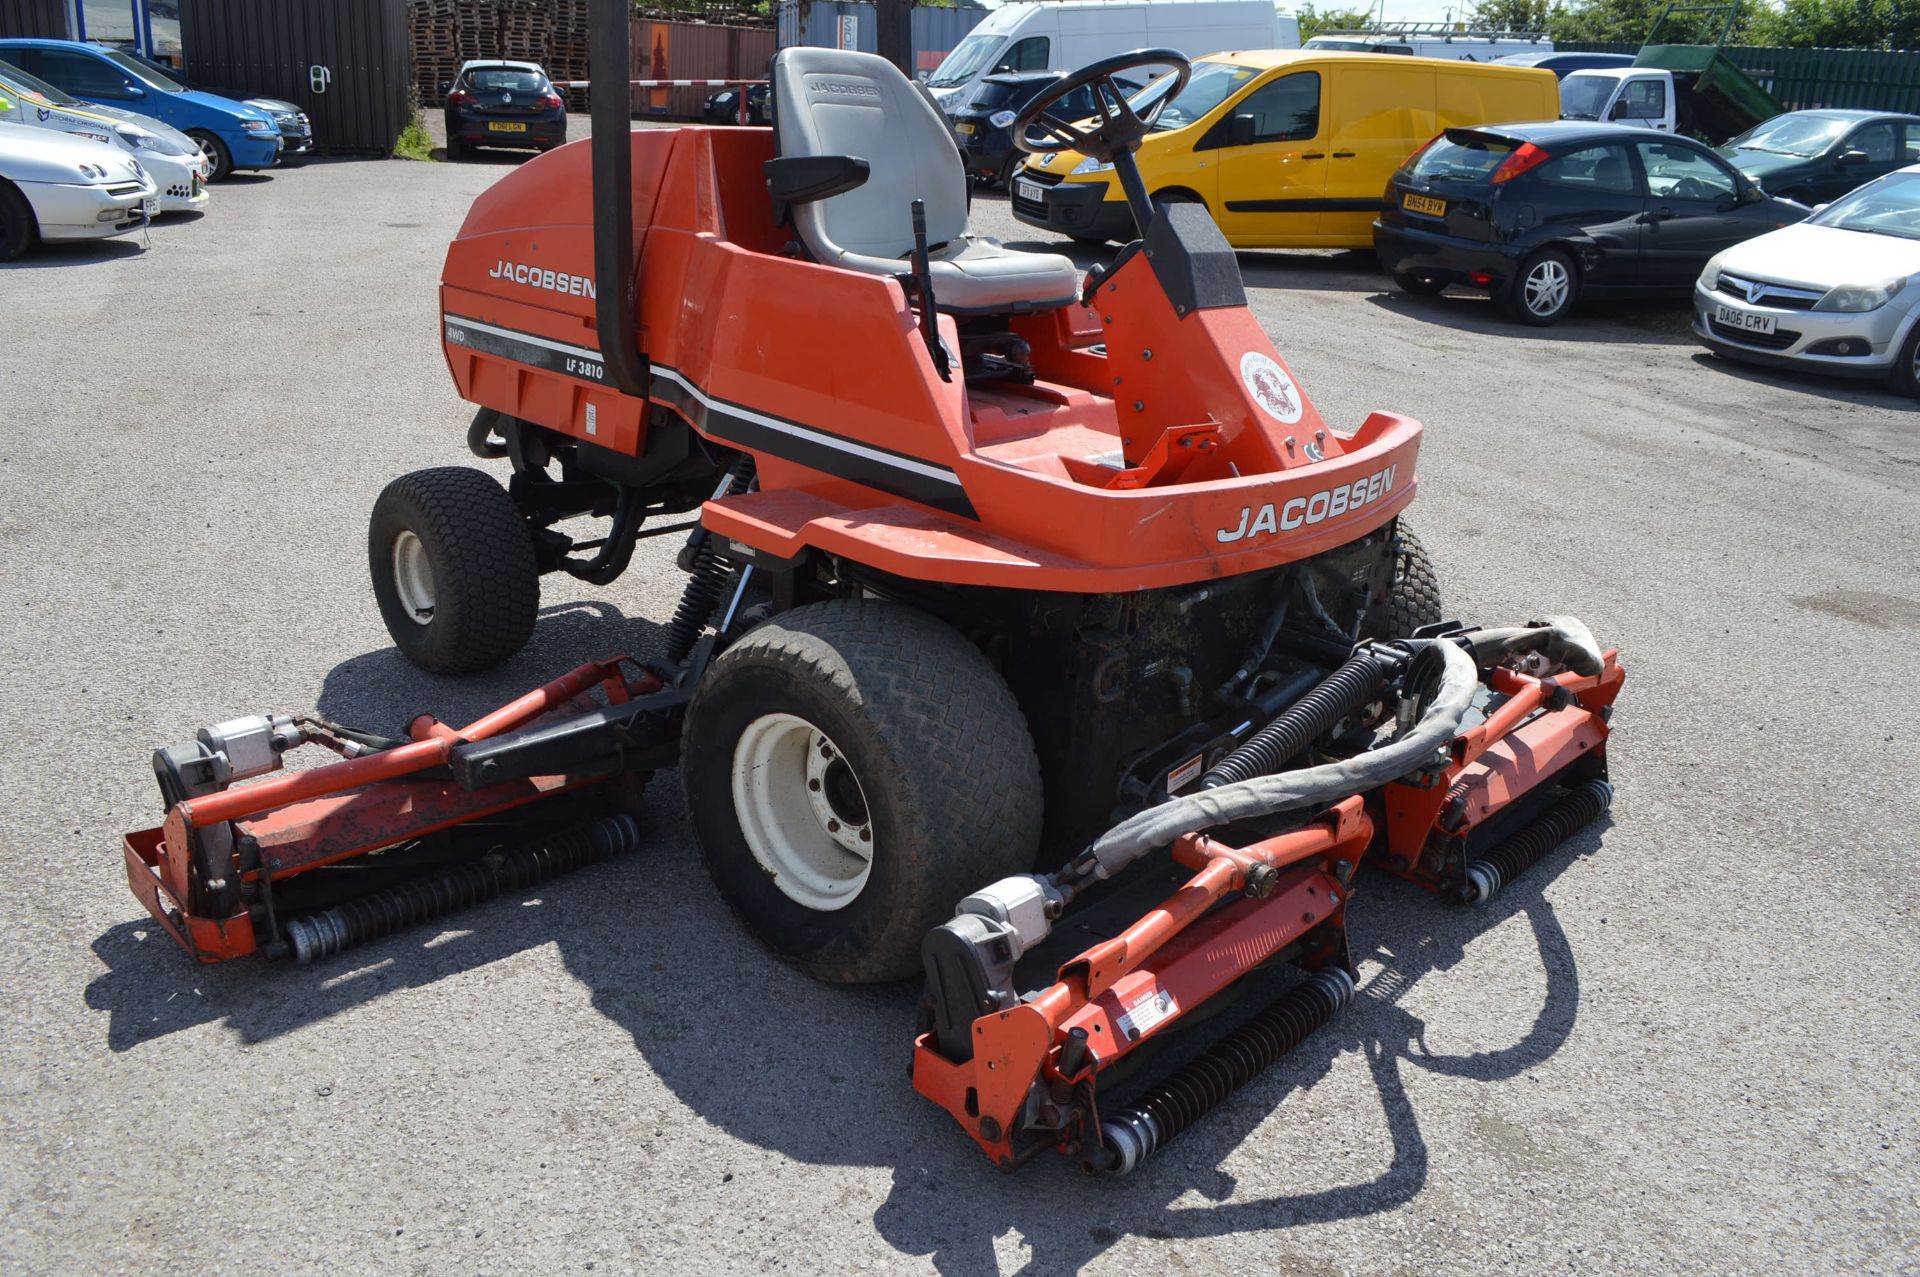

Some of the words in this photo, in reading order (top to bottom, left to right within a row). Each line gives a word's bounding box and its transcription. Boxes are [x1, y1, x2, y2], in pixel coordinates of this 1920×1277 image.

[811, 82, 881, 96] JACOBSEN
[1406, 195, 1426, 208] BN54
[489, 259, 596, 300] JACOBSEN
[1719, 307, 1743, 325] DA06
[1745, 314, 1770, 331] CRV
[447, 327, 465, 342] 4WD
[566, 357, 577, 372] LF
[578, 361, 604, 379] 3810
[1216, 463, 1397, 544] JACOBSEN
